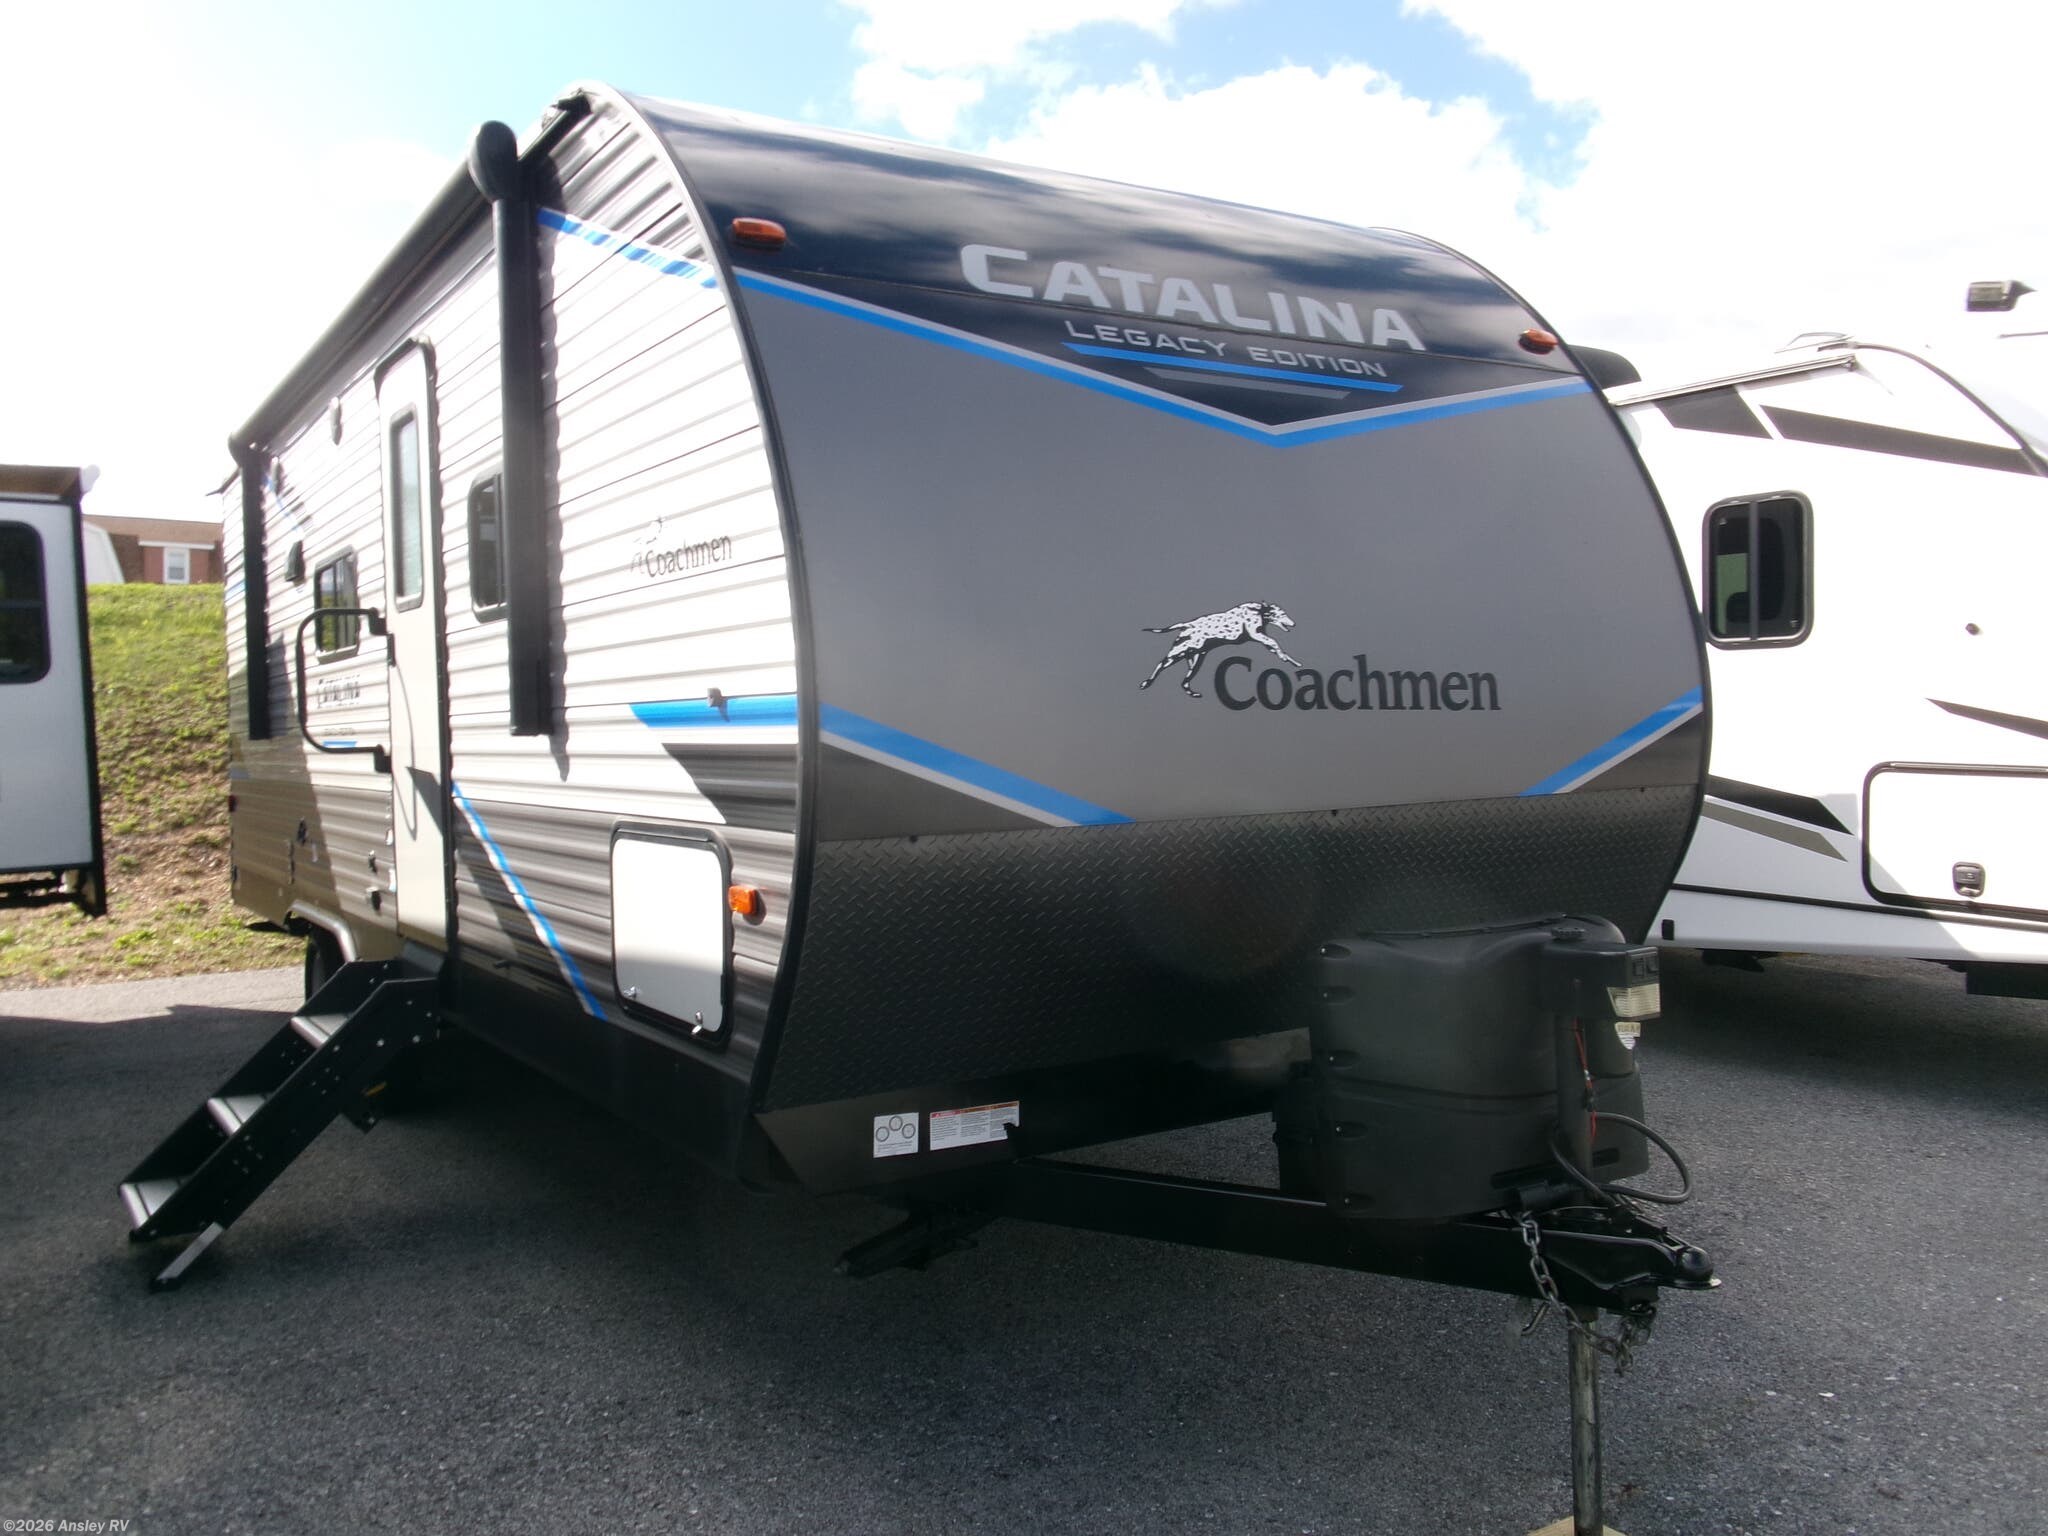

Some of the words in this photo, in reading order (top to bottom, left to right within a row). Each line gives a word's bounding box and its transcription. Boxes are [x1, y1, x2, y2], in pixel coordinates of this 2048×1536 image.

[960, 244, 1426, 351] CATALINA
[1065, 320, 1227, 357] LEGACY
[1250, 347, 1388, 378] EDITION
[645, 535, 732, 578] Coachmen
[1214, 654, 1502, 712] Coachmen
